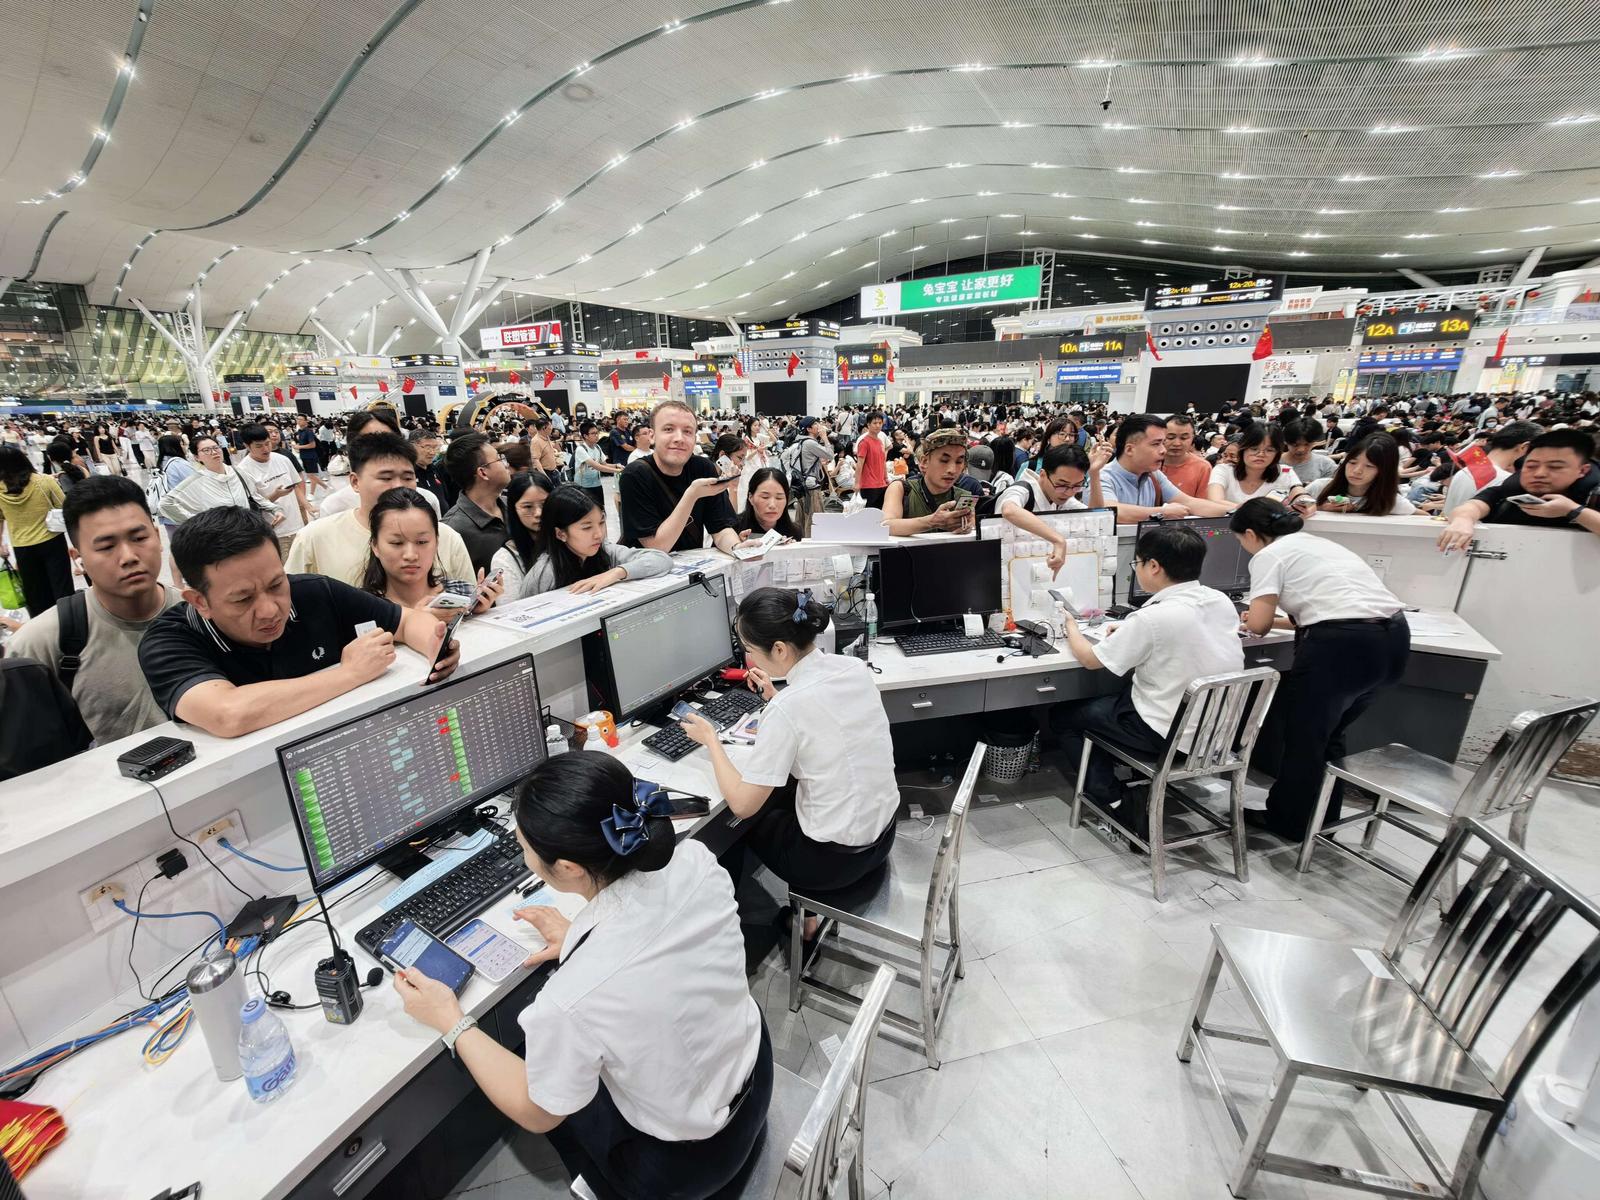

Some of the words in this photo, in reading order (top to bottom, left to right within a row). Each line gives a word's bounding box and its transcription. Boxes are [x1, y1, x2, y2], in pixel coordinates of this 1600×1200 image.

[923, 281, 958, 296] 兔宝宝
[961, 273, 1014, 291] 让家更好
[1366, 324, 1394, 336] 12A
[1440, 320, 1469, 332] 13A
[503, 329, 538, 343] 联盟管道
[1060, 343, 1077, 353] 10A
[1104, 341, 1122, 351] 11A
[872, 354, 883, 363] 9A
